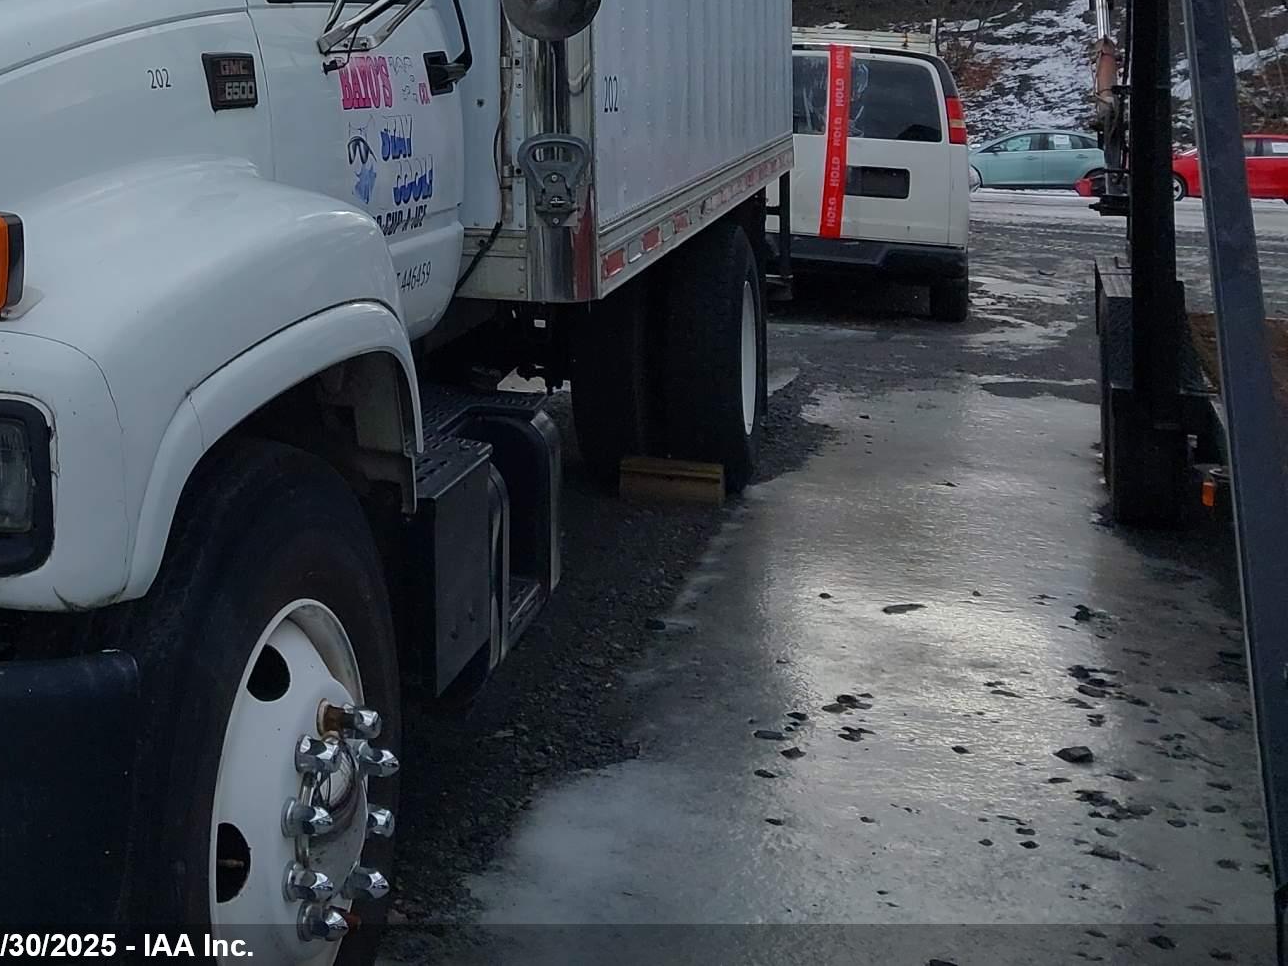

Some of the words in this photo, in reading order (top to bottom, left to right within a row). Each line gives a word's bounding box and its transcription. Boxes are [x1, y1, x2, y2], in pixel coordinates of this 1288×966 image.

[147, 68, 172, 89] 202
[220, 59, 249, 75] GMC
[225, 81, 256, 100] 6500
[604, 75, 618, 113] 202
[835, 77, 845, 107] HOLD
[833, 117, 843, 147] HOLD
[830, 156, 841, 187] HOLD
[826, 197, 837, 227] HOLD
[401, 261, 431, 292] 446459
